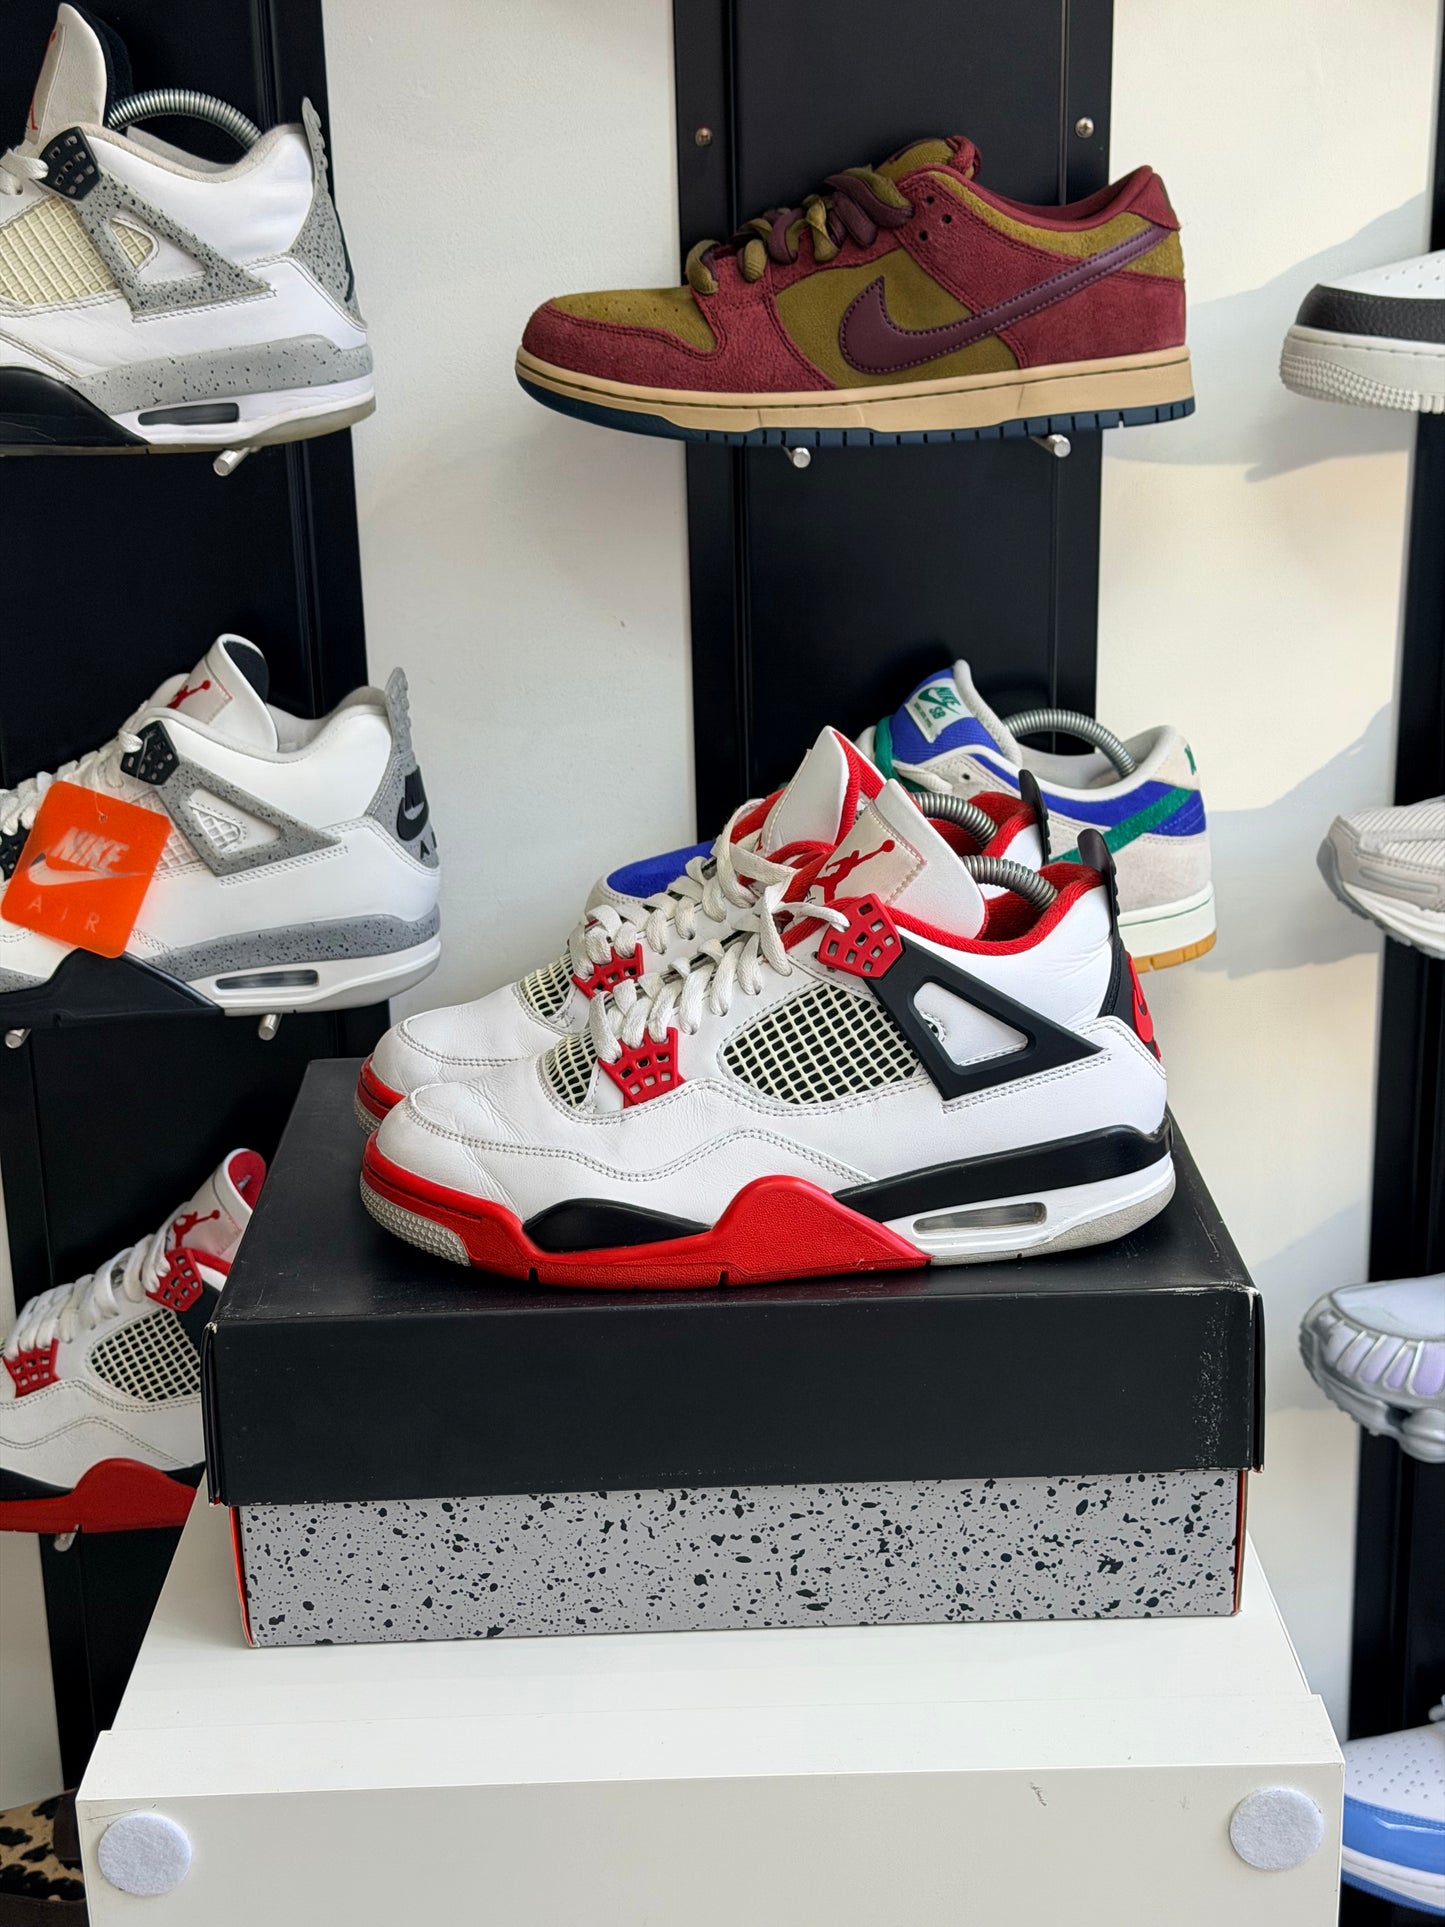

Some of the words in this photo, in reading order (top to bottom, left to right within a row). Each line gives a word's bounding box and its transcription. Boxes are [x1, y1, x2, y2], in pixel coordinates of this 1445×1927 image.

[929, 706, 946, 719] SB
[50, 826, 129, 872] NIKE
[27, 894, 100, 933] AIR
